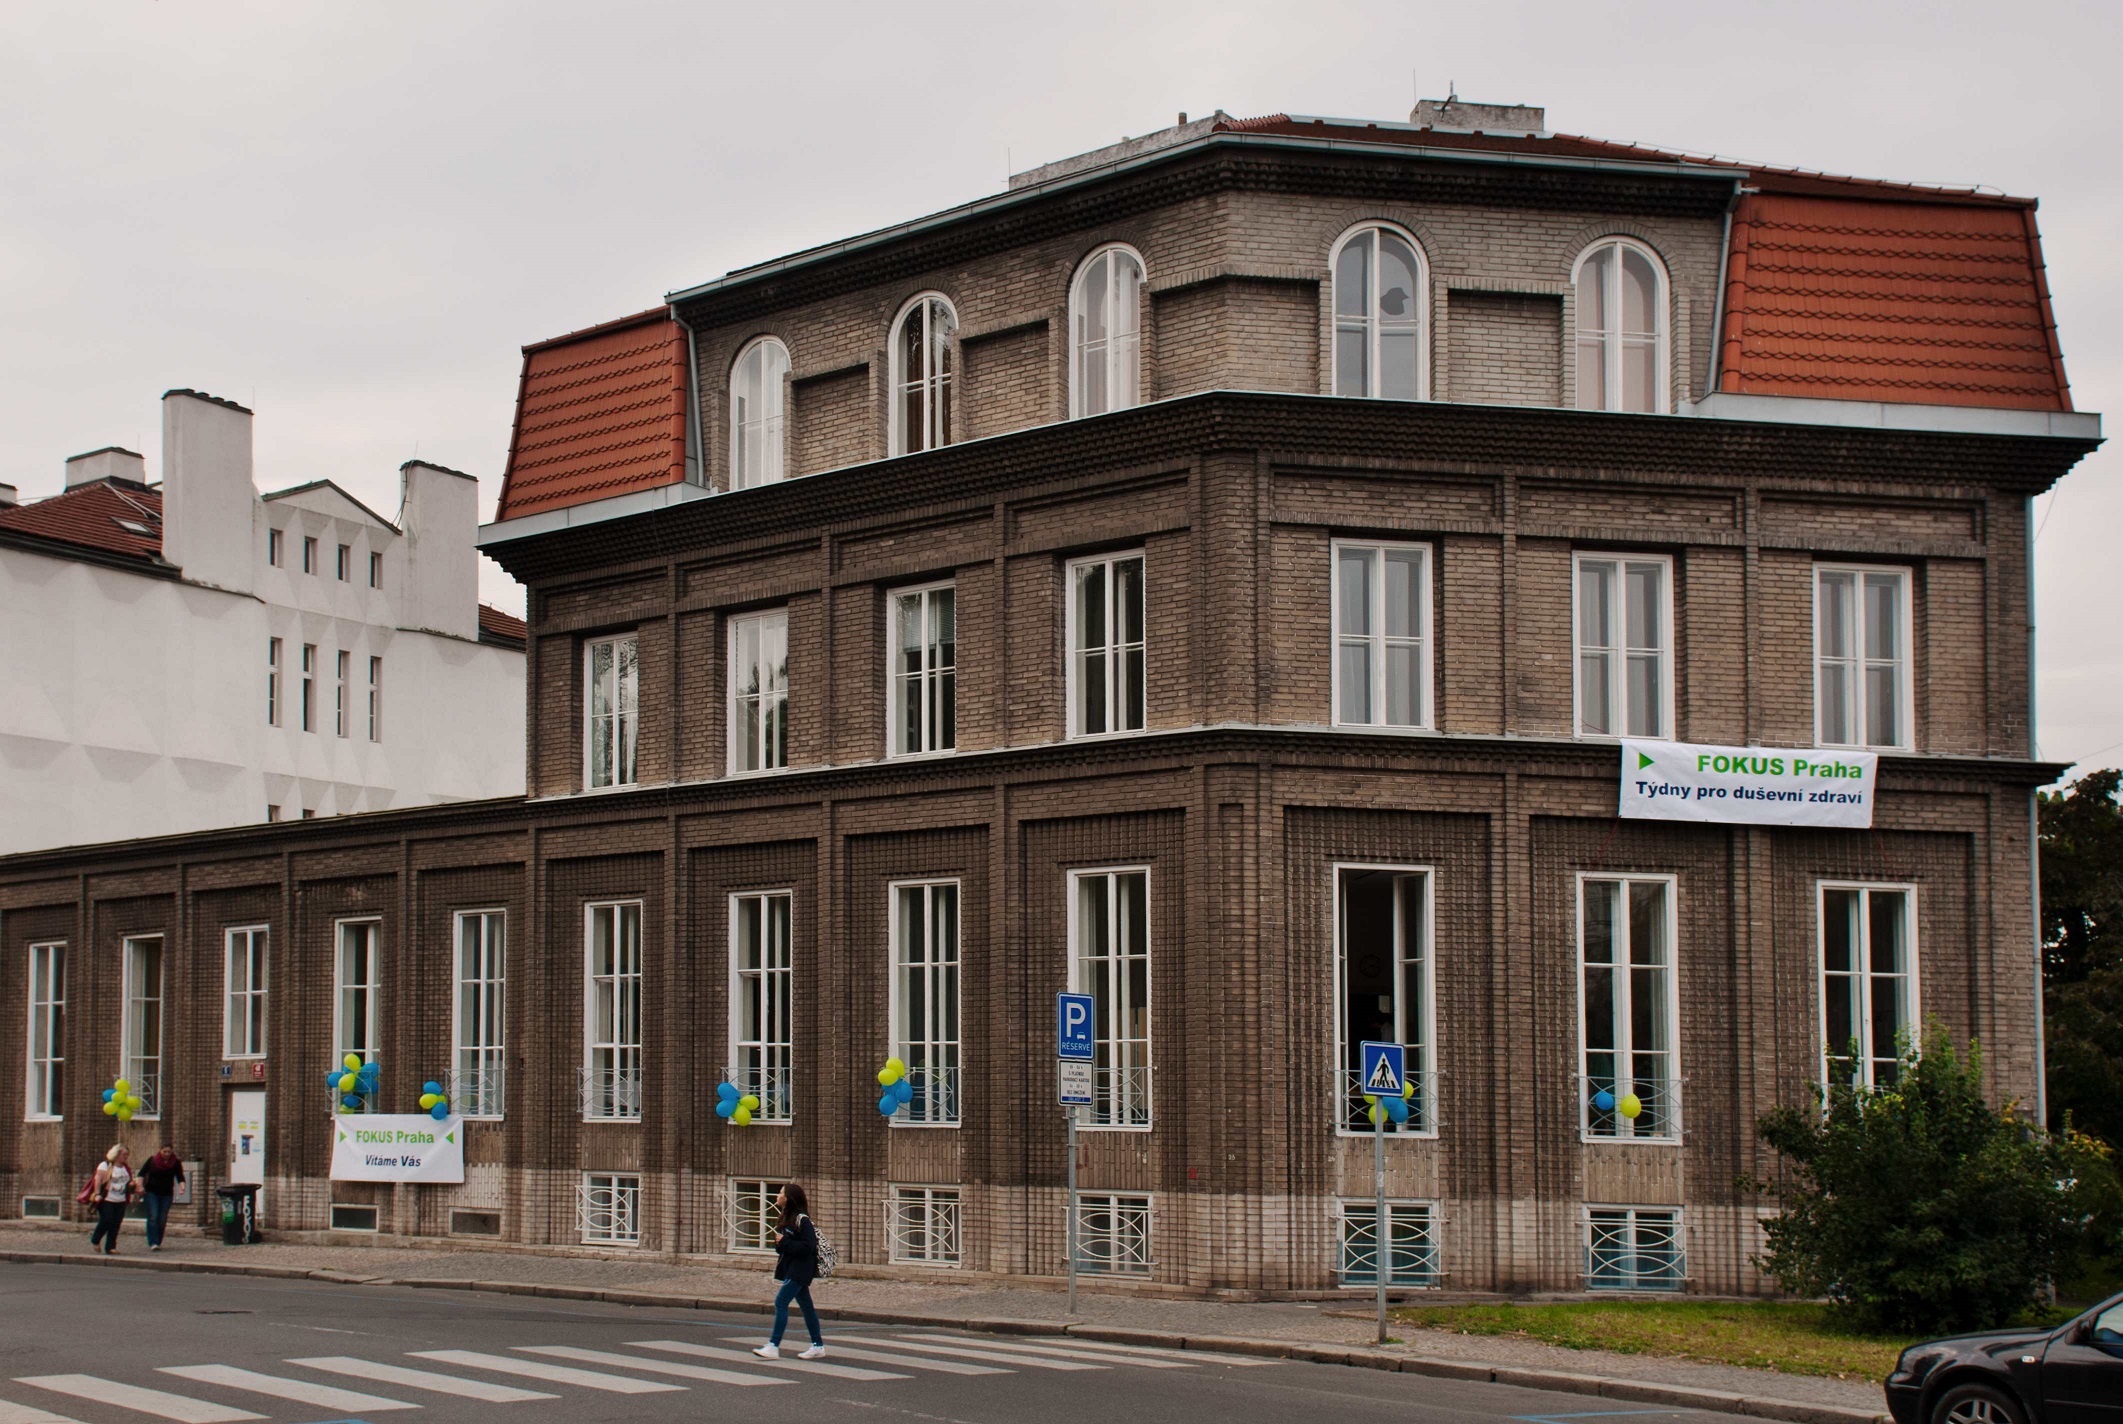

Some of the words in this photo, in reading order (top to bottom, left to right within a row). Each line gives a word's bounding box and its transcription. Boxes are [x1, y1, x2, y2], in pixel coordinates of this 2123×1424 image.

[1697, 754, 1785, 776] FOKUS
[1793, 759, 1863, 779] Praha
[1635, 781, 1691, 799] Týdny
[1697, 787, 1727, 801] pro
[1733, 785, 1803, 802] duševní
[1808, 790, 1863, 804] zdraví
[1066, 1002, 1087, 1038] P
[1061, 1041, 1091, 1052] RÉSERVÉ
[355, 1130, 393, 1143] FOKUS
[396, 1130, 435, 1144] Praha
[365, 1154, 398, 1166] Vítáme
[401, 1155, 422, 1167] Vás
